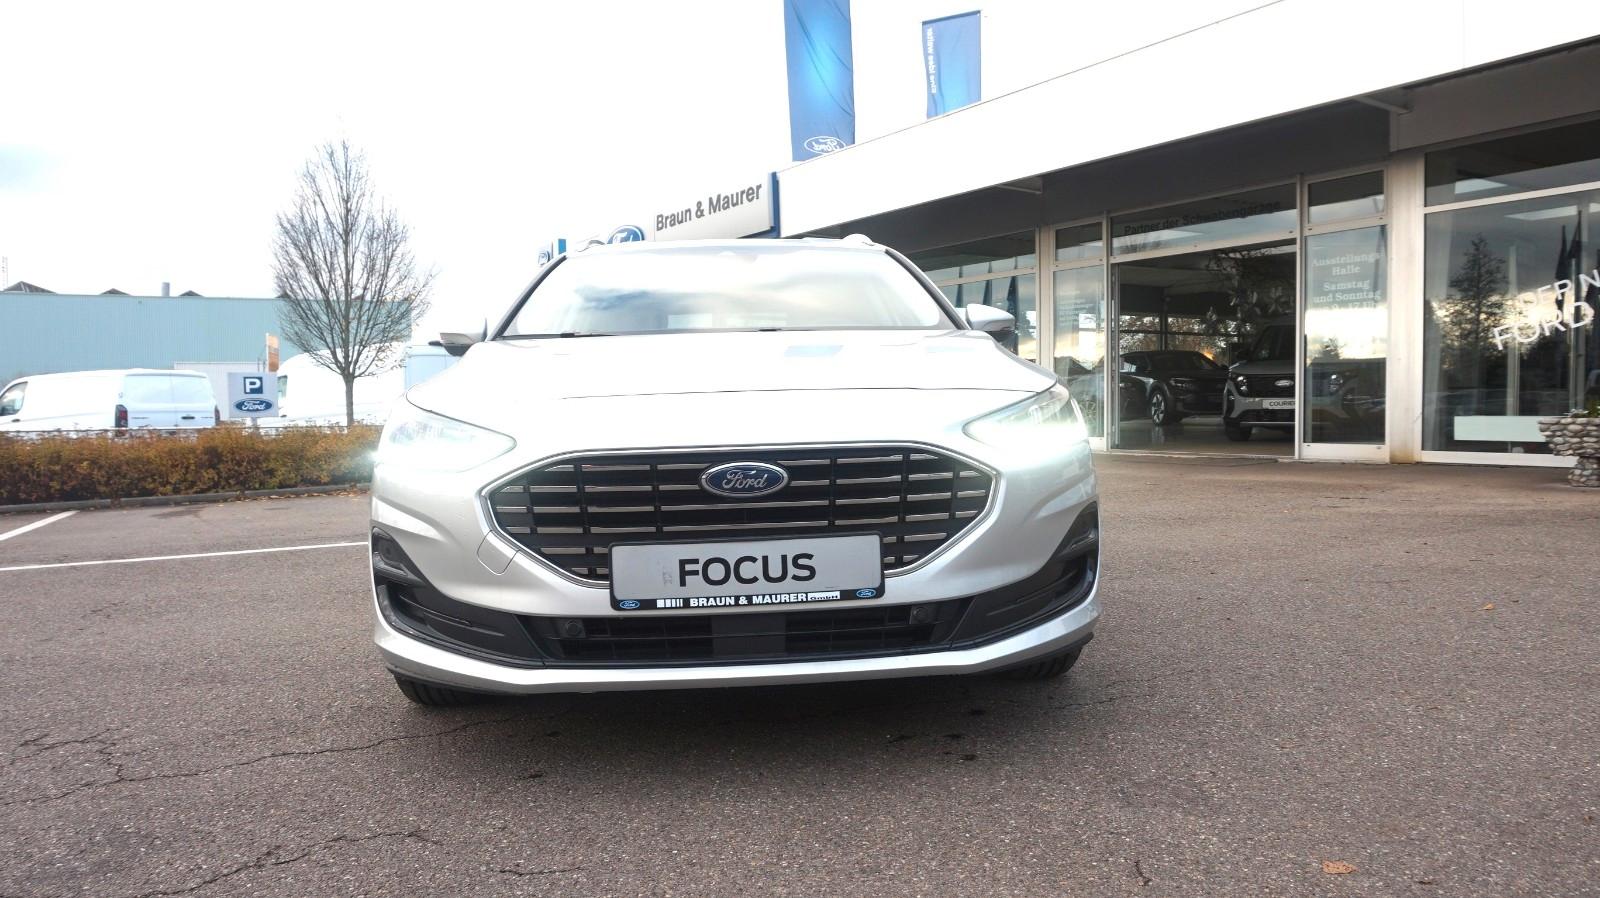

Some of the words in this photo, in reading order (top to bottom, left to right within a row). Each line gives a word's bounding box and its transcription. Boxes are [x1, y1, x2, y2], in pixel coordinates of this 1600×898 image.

[656, 208, 692, 231] Braun
[695, 200, 705, 219] &
[708, 184, 762, 215] Maurer
[1124, 222, 1160, 236] Partner
[1161, 215, 1179, 231] der
[1332, 265, 1361, 276] Halle
[1323, 280, 1370, 292] Samstag
[1313, 293, 1333, 303] und
[1335, 290, 1382, 301] Sonntag
[1494, 301, 1595, 350] FORD
[246, 378, 260, 393] P
[242, 400, 265, 411] Ford
[722, 470, 768, 488] Ford
[679, 553, 816, 587] FOCUS
[690, 596, 735, 607] BRAUN
[739, 596, 748, 605] &
[752, 593, 806, 604] MAURER
